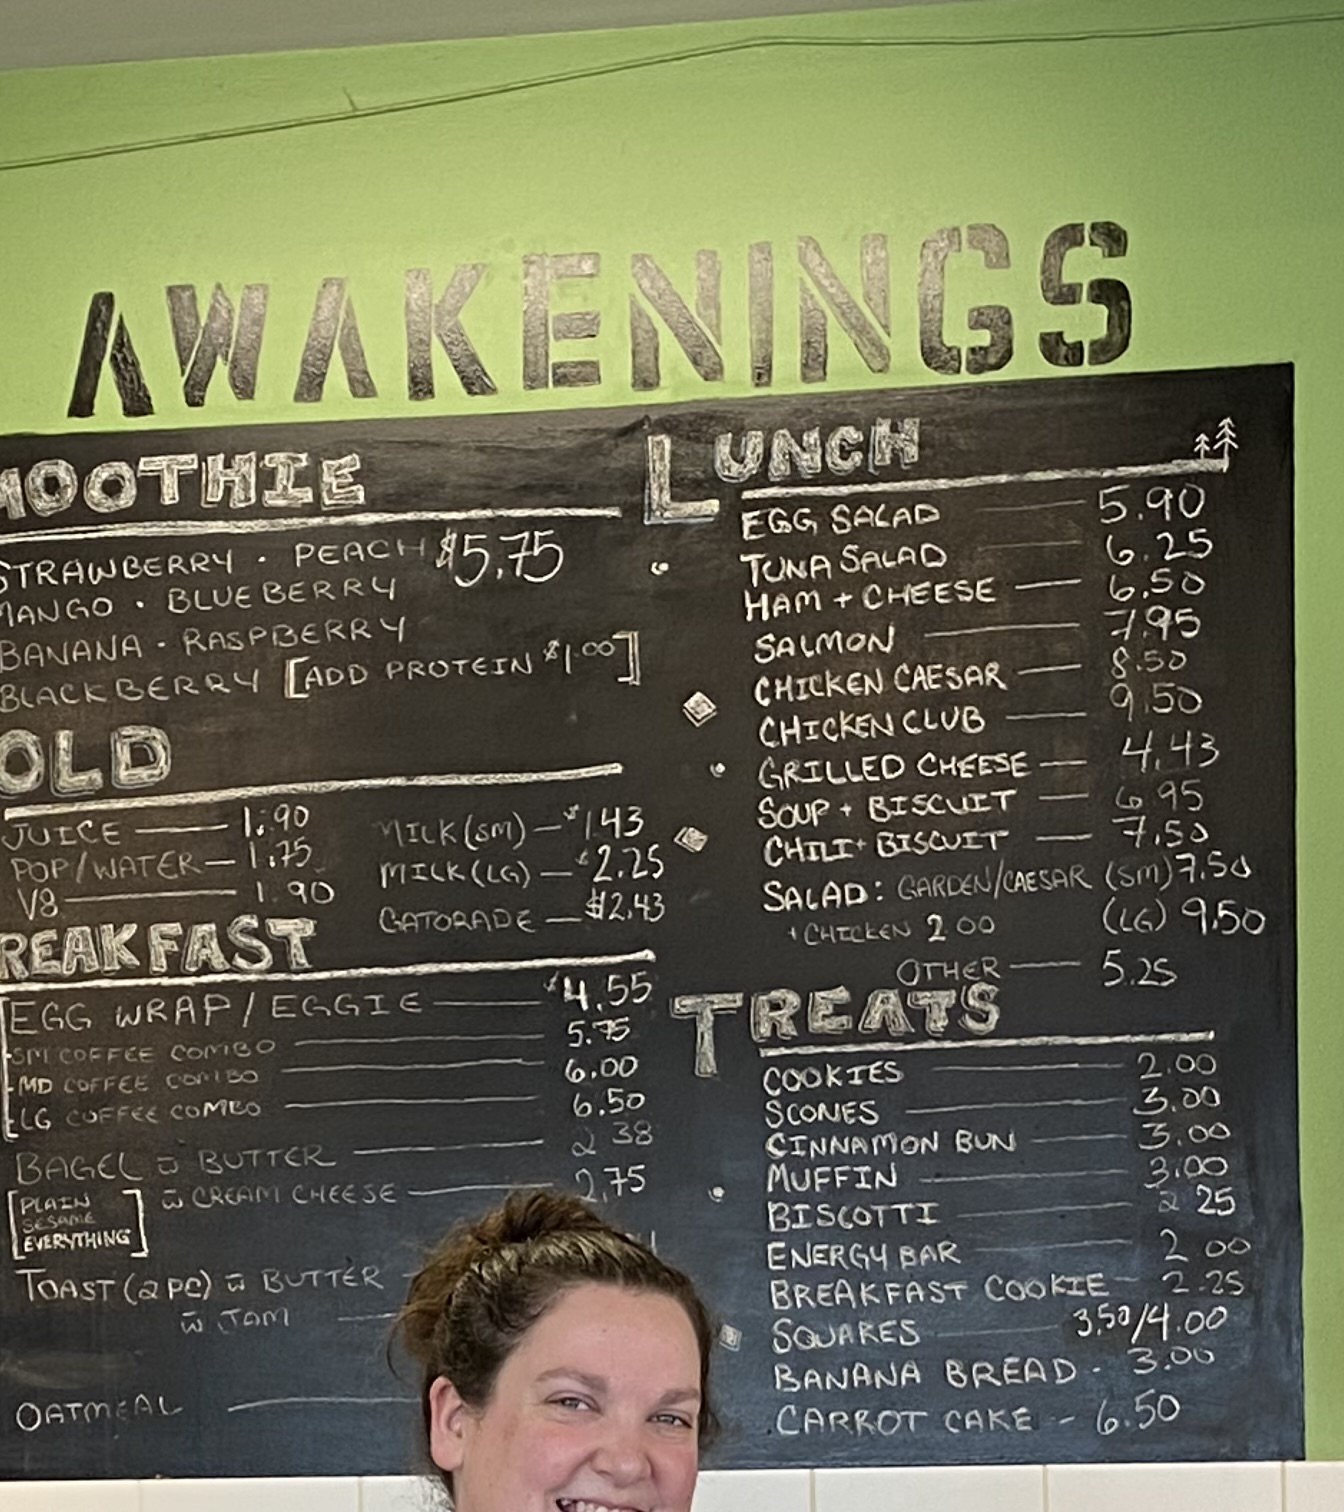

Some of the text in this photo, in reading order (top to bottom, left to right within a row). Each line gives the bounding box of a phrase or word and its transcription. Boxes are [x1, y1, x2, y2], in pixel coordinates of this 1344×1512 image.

[67, 219, 1133, 418] AWAKENINGS
[643, 417, 920, 525] LUNCH
[742, 510, 818, 540] EGG
[832, 504, 940, 533] SALAD
[294, 539, 426, 568] PEACH
[740, 543, 947, 586] TUNA SALAD
[745, 578, 996, 622] HAM CHEESE
[182, 616, 406, 655] RASPBERRY
[755, 626, 894, 664] SALMON
[385, 656, 532, 680] PROTEIN
[755, 663, 1007, 705] CHICKEN CAESAR
[759, 706, 984, 747] CHICKEN CLUB
[759, 752, 1031, 791] GRILLED CHEESE
[2, 820, 120, 850] JUICE
[876, 831, 1009, 856] BISCUIT
[18, 891, 58, 918] V8
[379, 905, 536, 932] GATORADE
[896, 956, 1000, 985] OTHER
[10, 1001, 91, 1033] EGG
[669, 982, 1001, 1077] TREATS
[763, 1059, 904, 1096] COOKIES
[765, 1101, 879, 1126] SCONES
[766, 1130, 1015, 1160] CINNAMON BUN
[16, 1145, 337, 1184] BAGEL BUTTER
[766, 1162, 897, 1193] MUFFIN
[192, 1184, 396, 1208] CREAM CHEESE
[768, 1202, 940, 1232] BISCOTTI
[23, 1231, 132, 1251] EVERYTHING
[767, 1241, 961, 1273] ENERGY BAR
[771, 1273, 1109, 1311] BREAKFAST COOKIE
[772, 1318, 921, 1354] SQUARES
[773, 1357, 1076, 1392] BANANA BREAD
[777, 1404, 927, 1436] CARROT
[944, 1407, 1032, 1433] CAKE
